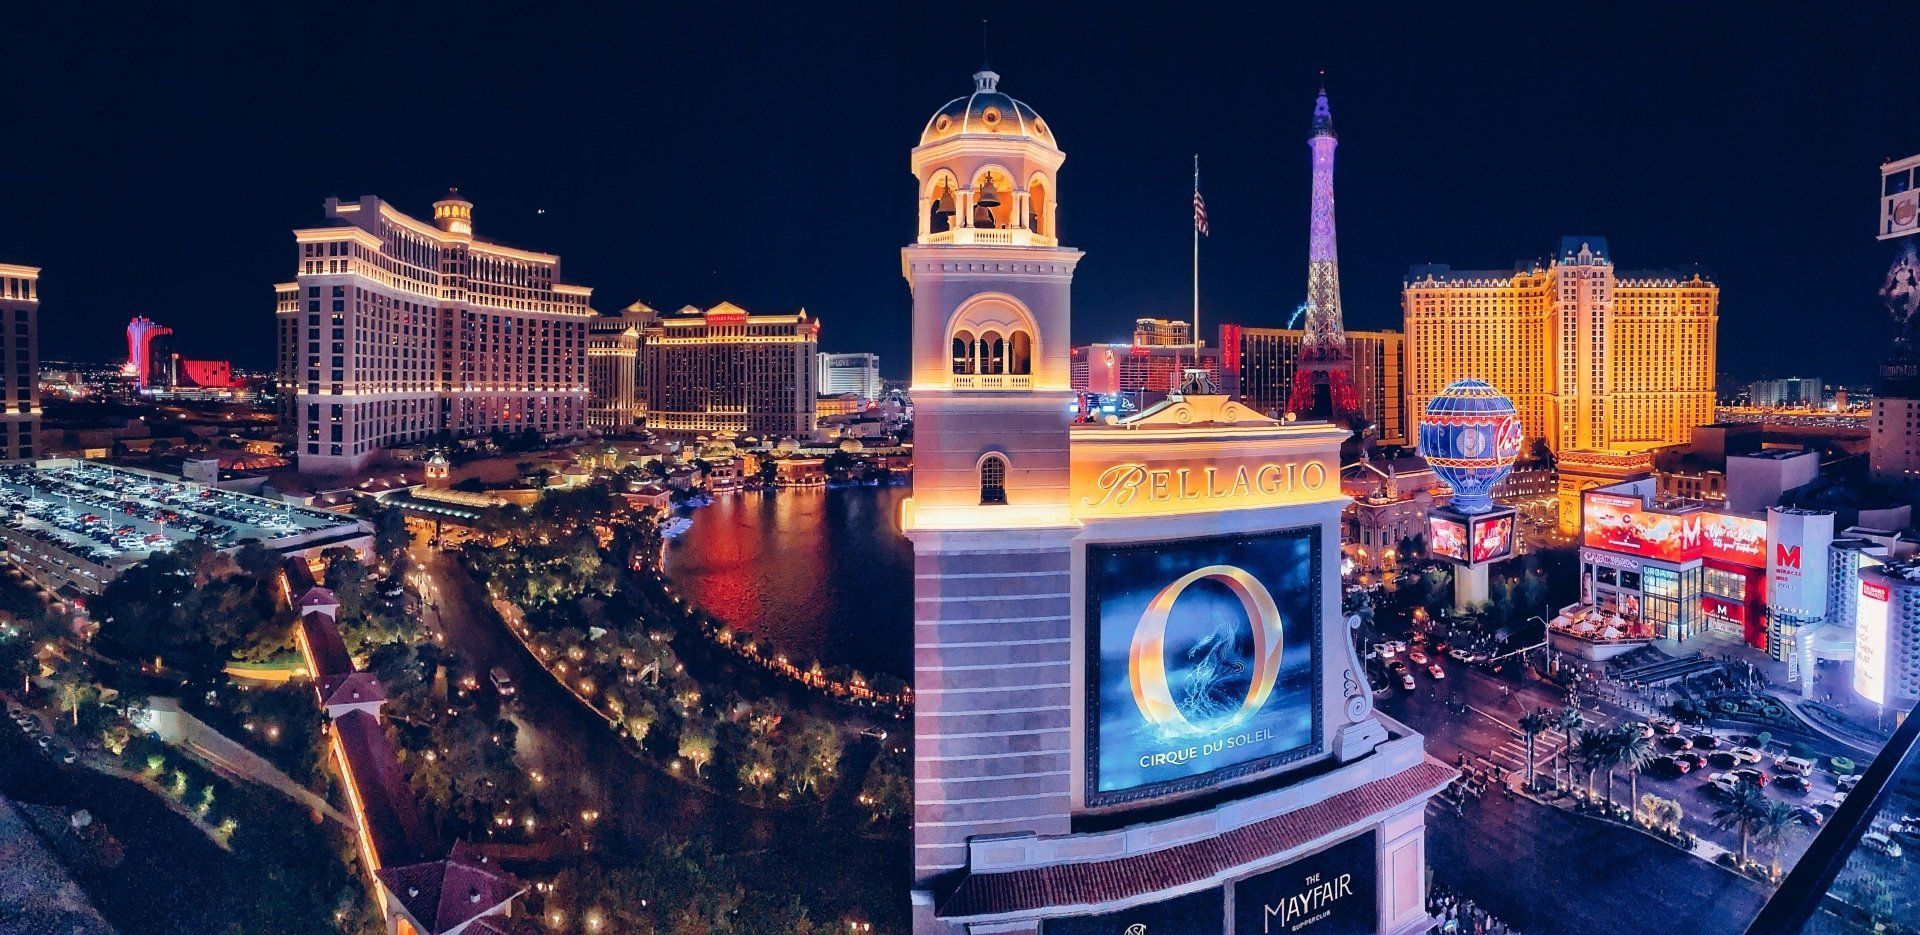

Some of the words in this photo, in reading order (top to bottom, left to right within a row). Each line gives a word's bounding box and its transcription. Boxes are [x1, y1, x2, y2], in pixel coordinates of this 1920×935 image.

[1080, 460, 1327, 508] BELLAGIO
[1776, 543, 1802, 569] M
[1139, 747, 1198, 768] CIRQUE
[1203, 740, 1223, 756] DU
[1227, 727, 1275, 748] SOLEIL
[1306, 873, 1320, 886] THE
[1264, 873, 1353, 934] MAYFAIR
